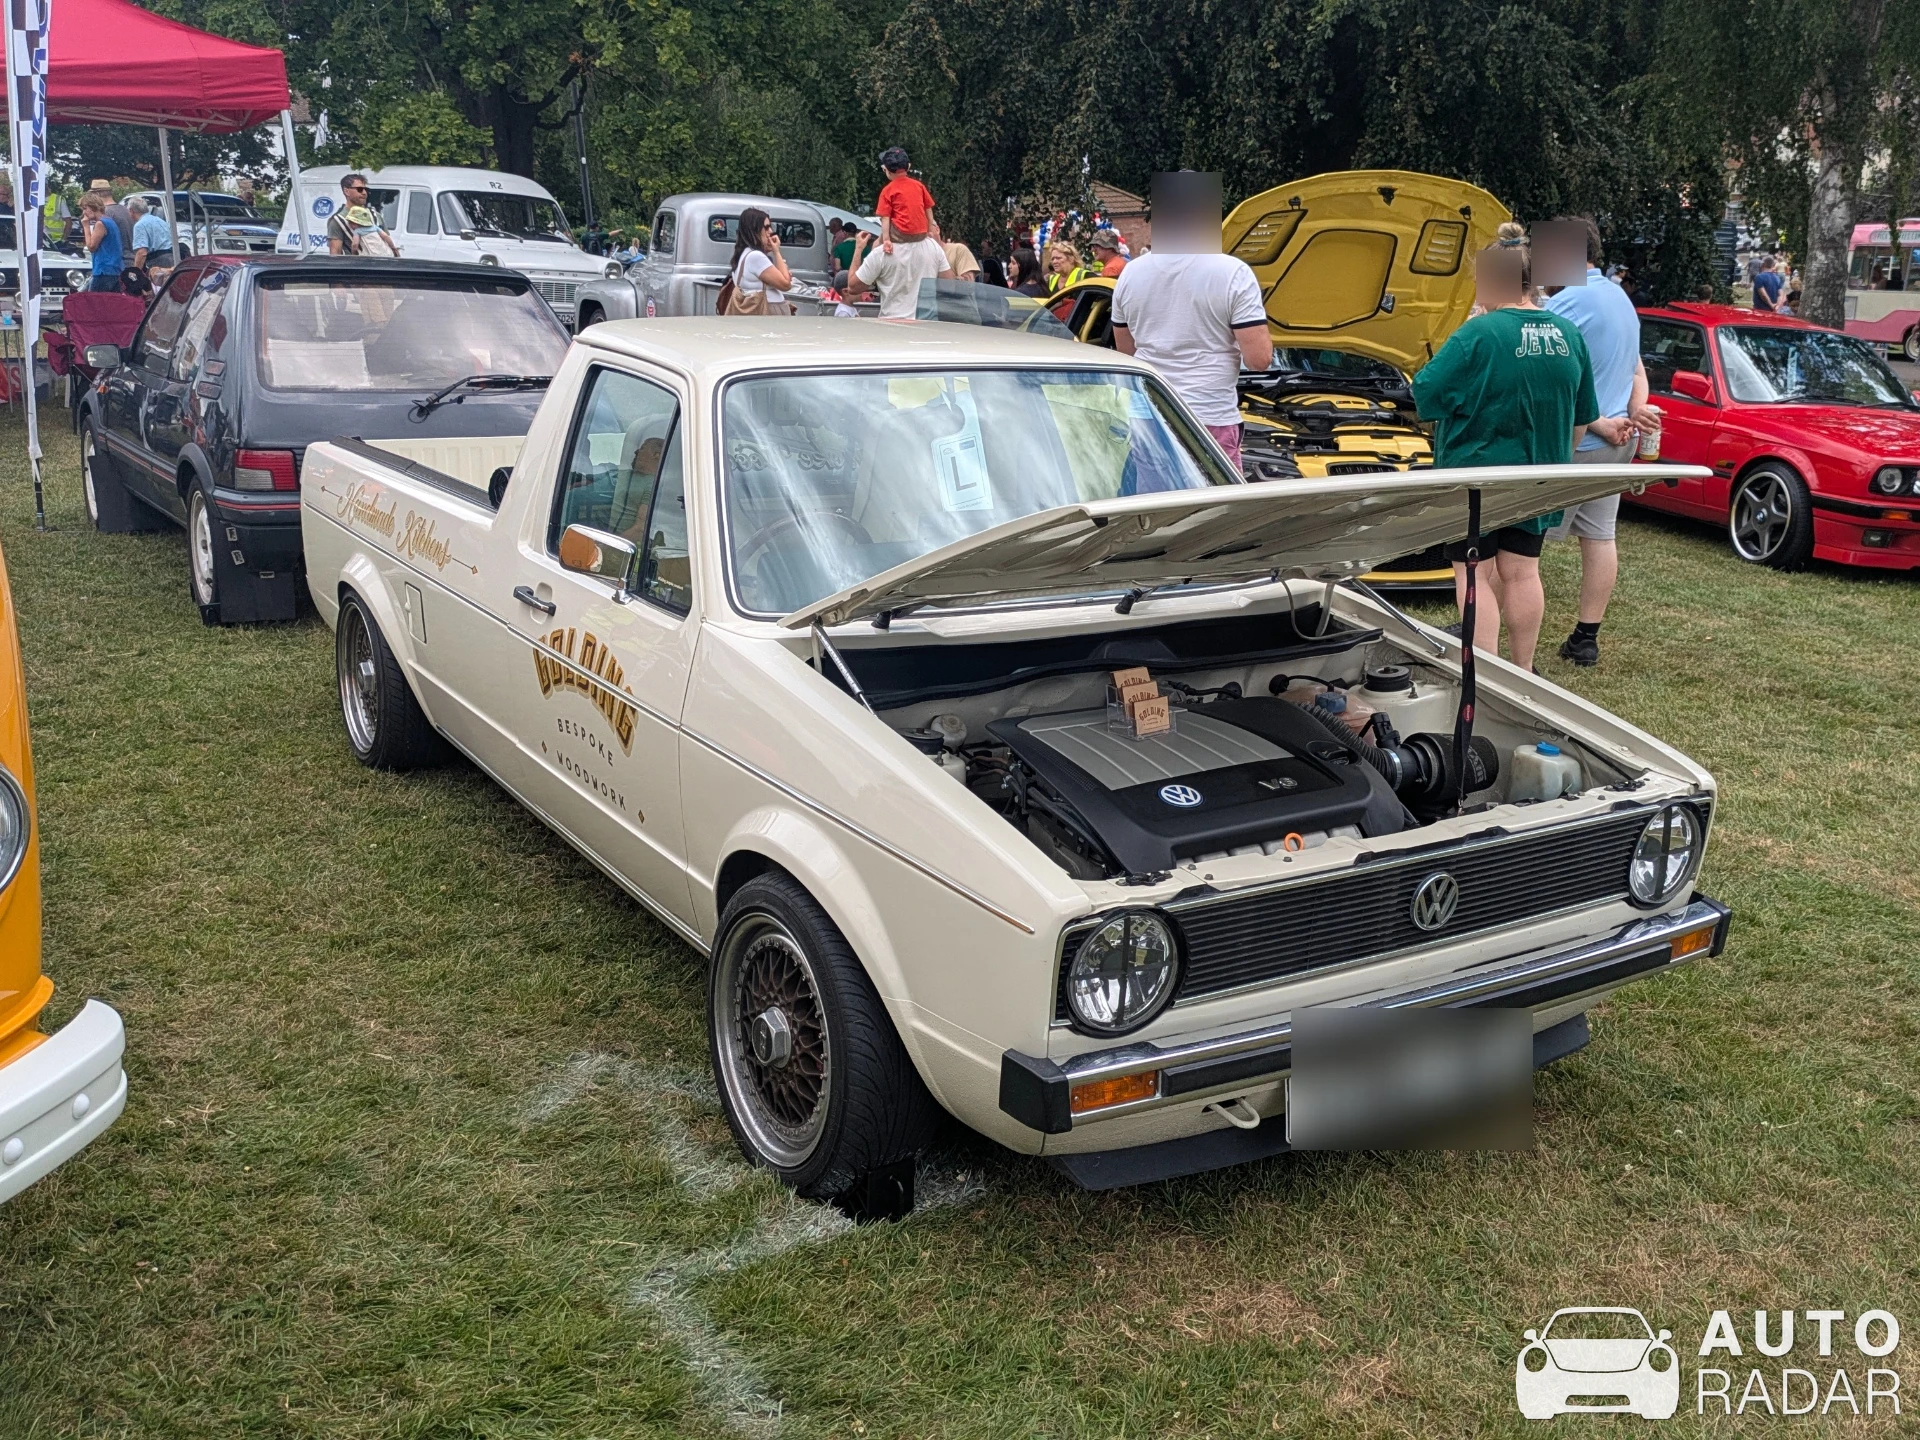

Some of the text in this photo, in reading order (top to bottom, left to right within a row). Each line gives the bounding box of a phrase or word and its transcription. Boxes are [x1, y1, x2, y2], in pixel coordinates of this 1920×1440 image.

[315, 200, 331, 214] Ford
[1515, 327, 1569, 357] JETS
[951, 456, 977, 491] L
[337, 482, 452, 572] Handmade Kitchens
[533, 627, 639, 757] GOLDING
[1139, 706, 1165, 721] GOLDING
[557, 718, 614, 767] BESPOKE
[556, 750, 626, 811] WOODWORK
